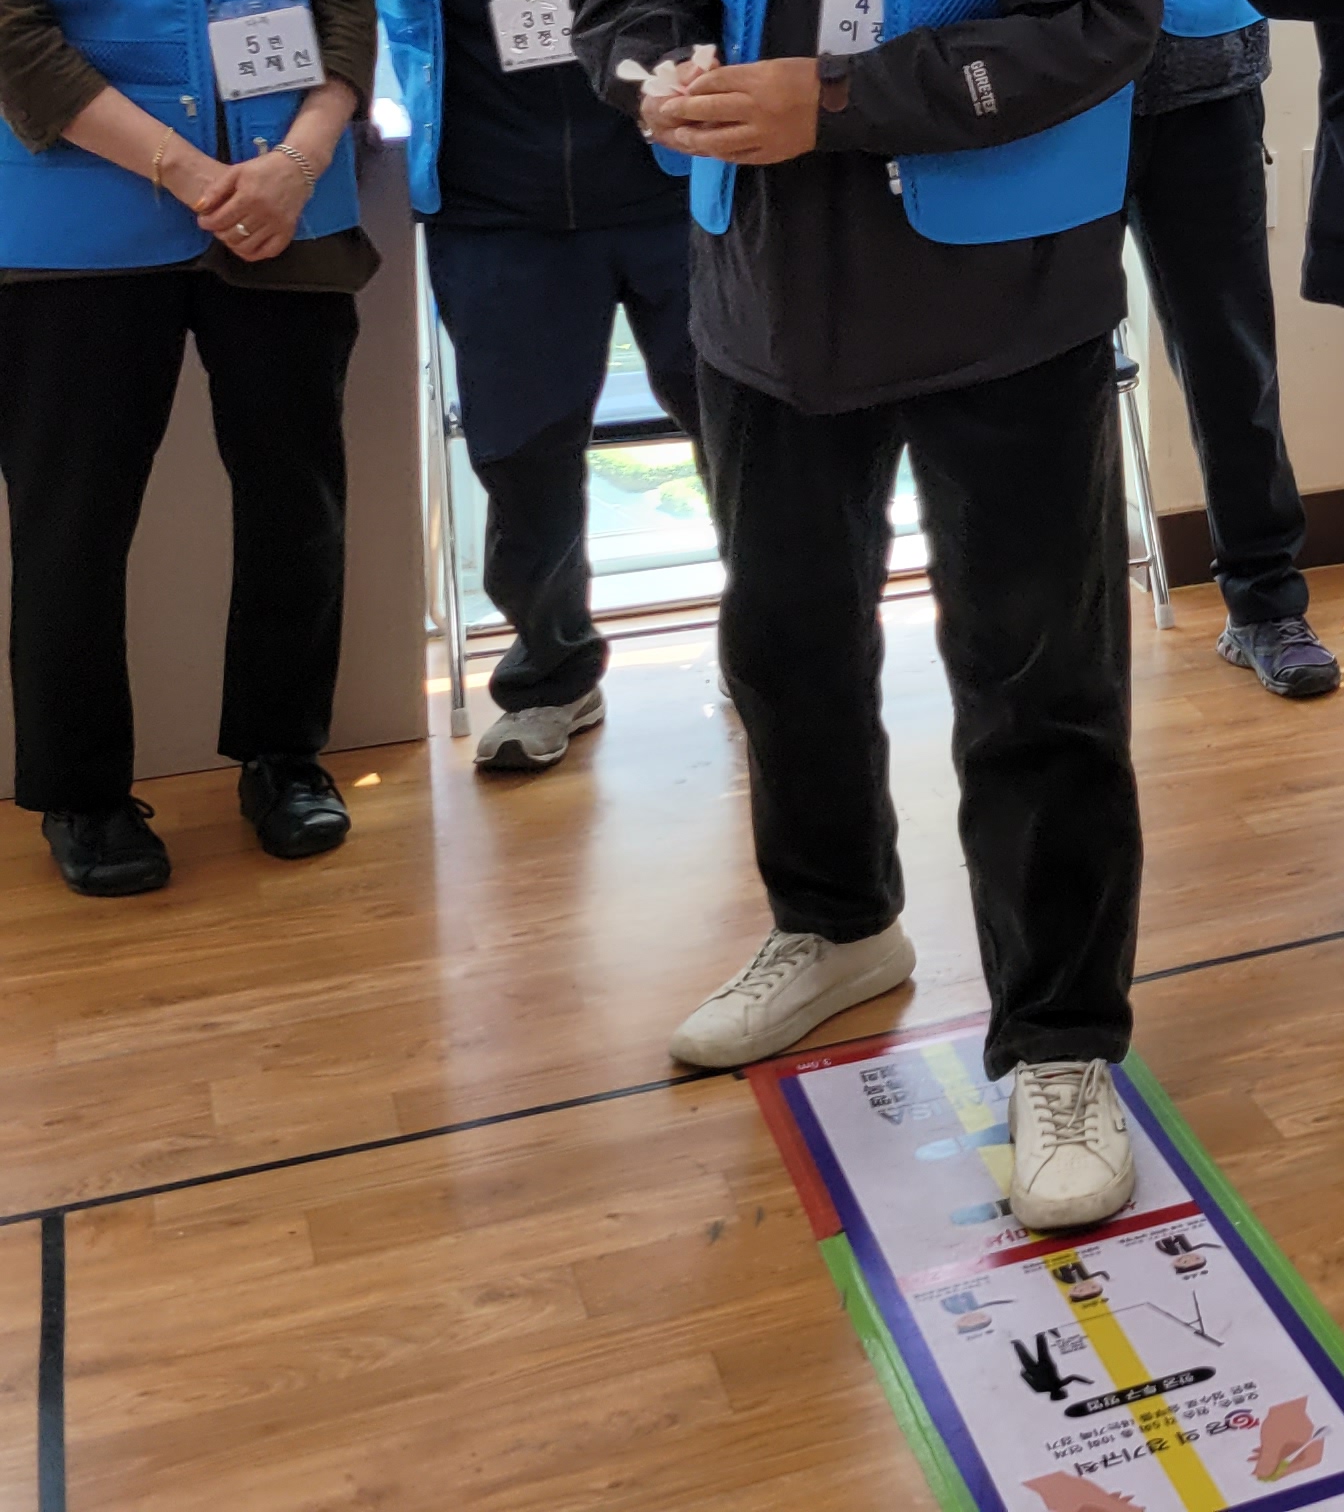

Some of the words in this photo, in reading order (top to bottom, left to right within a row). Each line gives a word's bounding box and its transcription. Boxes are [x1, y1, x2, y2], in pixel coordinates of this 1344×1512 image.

[521, 11, 535, 28] 3
[246, 35, 261, 54] 5
[970, 60, 999, 115] GORE-TEX
[1073, 1437, 1170, 1477] 경기규칙
